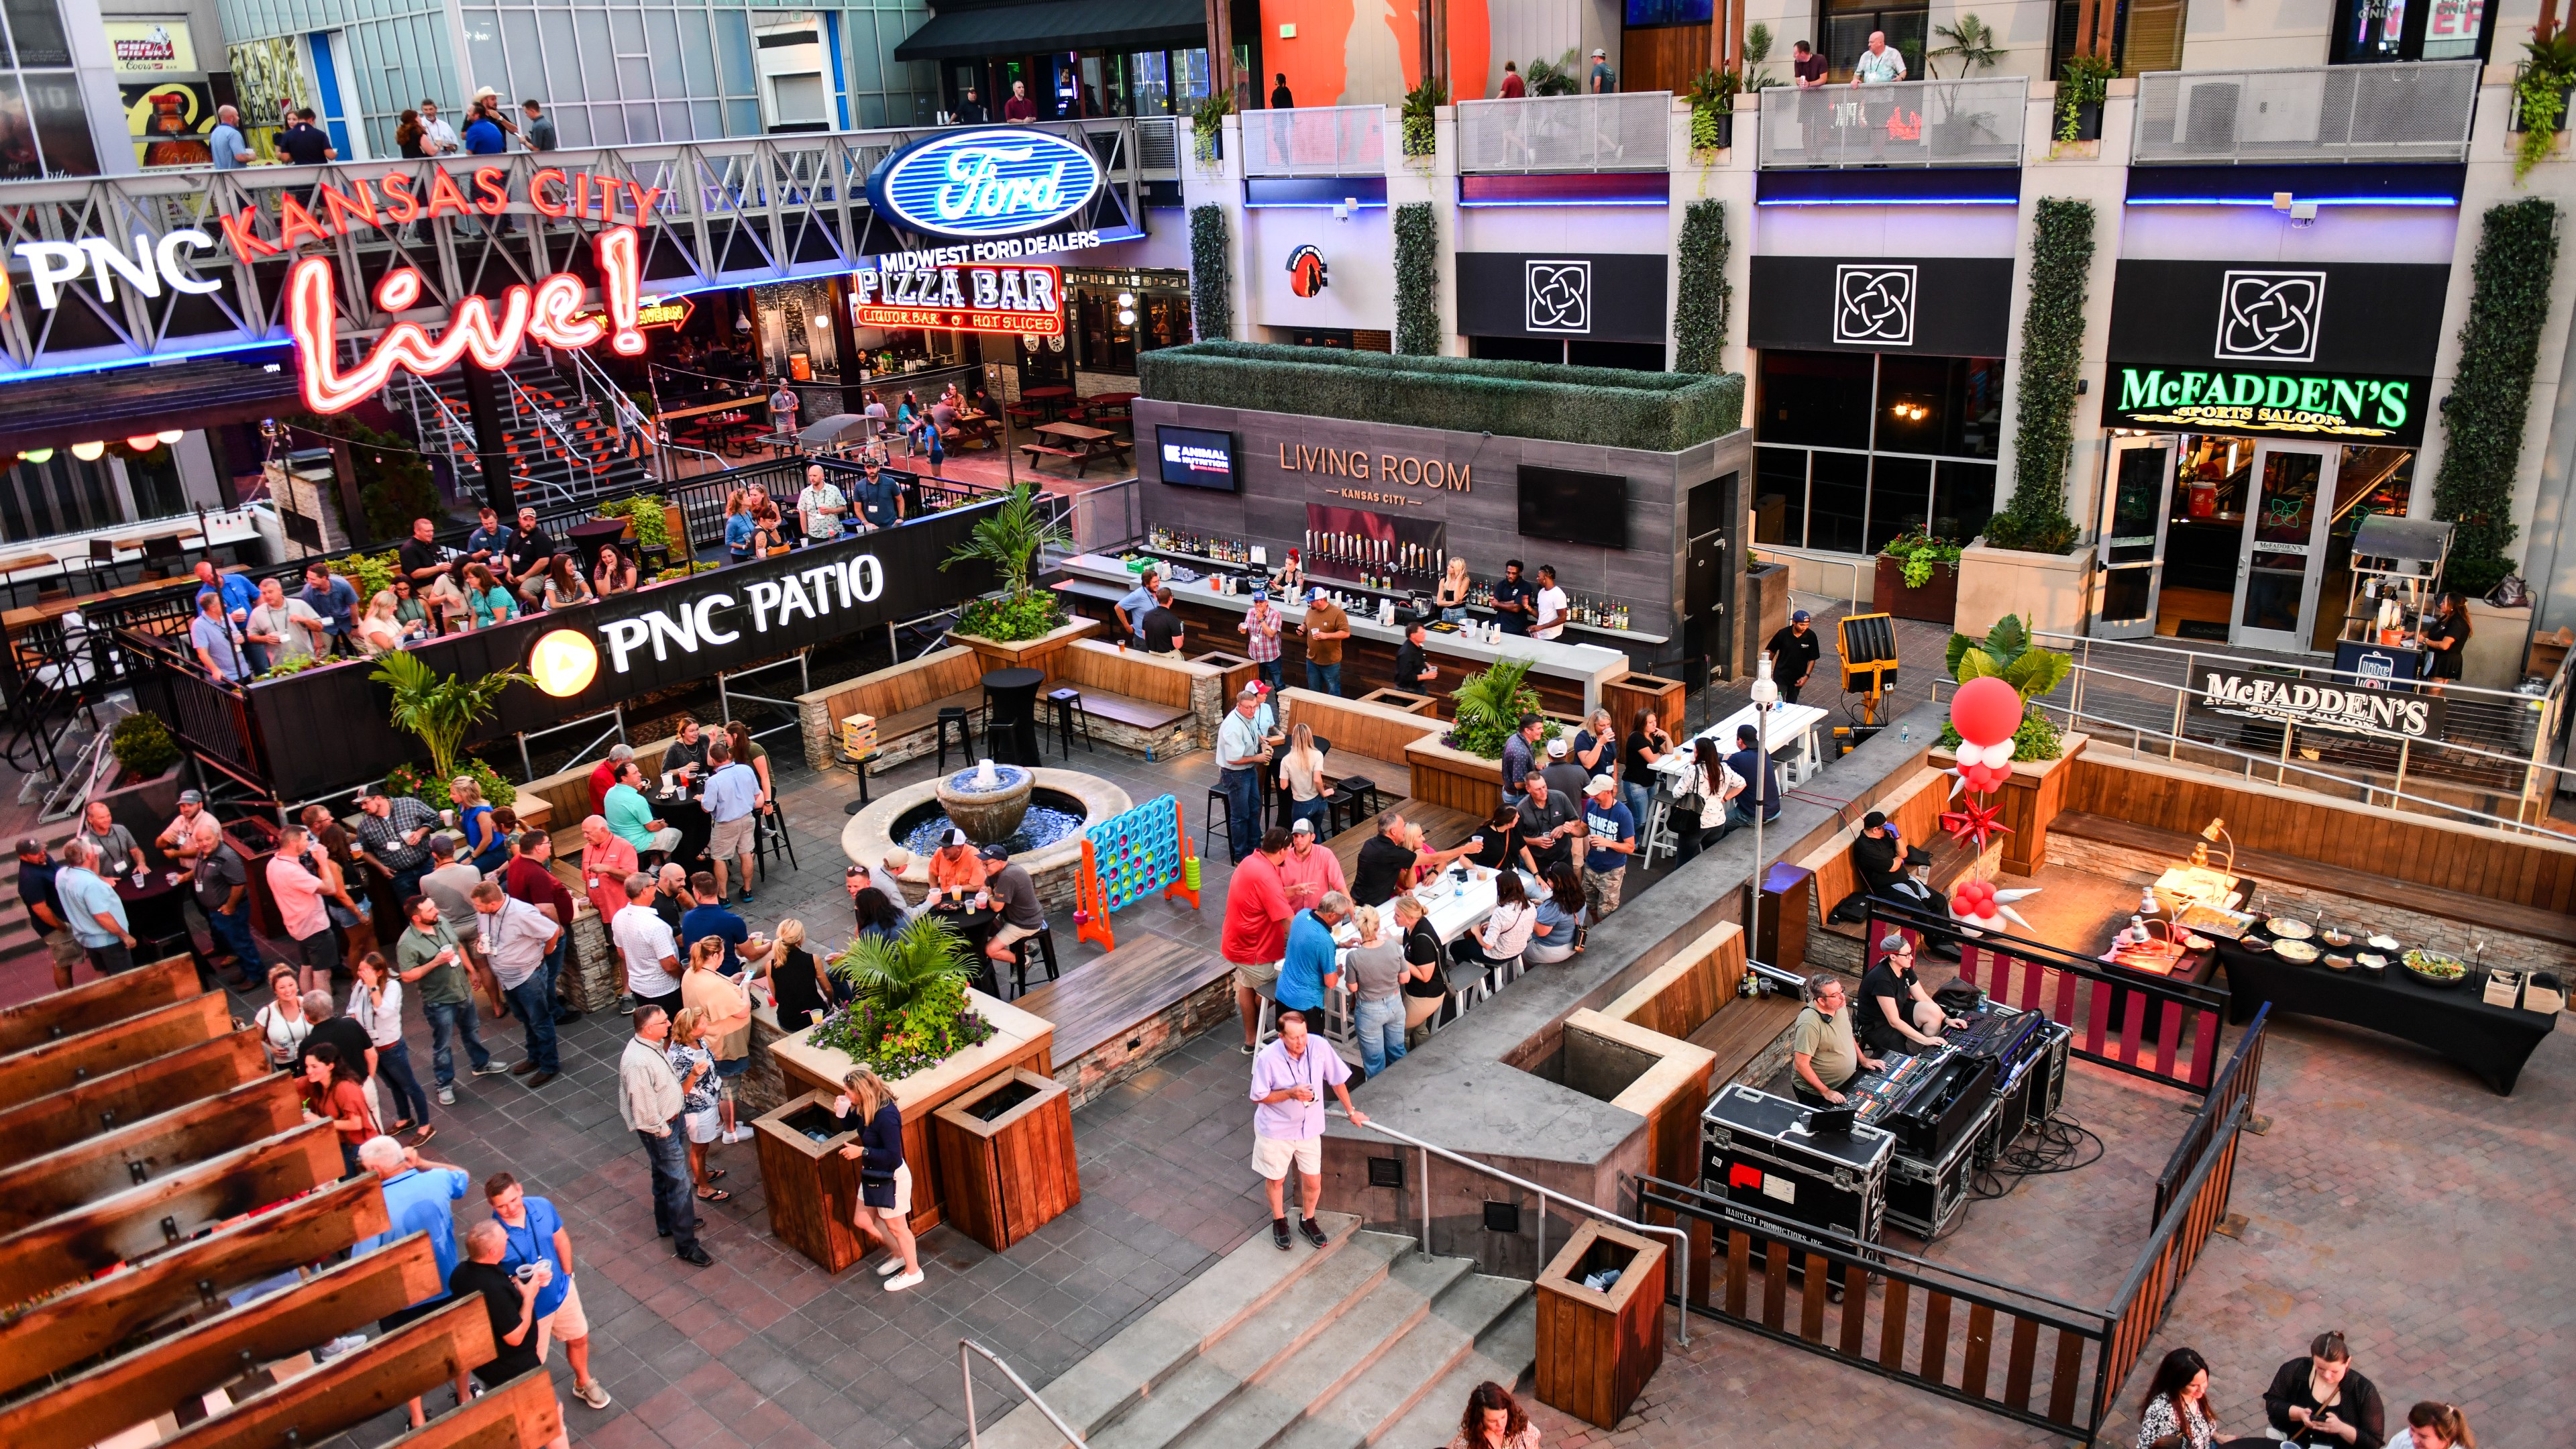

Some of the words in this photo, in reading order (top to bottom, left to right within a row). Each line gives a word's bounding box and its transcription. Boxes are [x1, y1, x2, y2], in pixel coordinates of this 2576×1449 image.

[2358, 8, 2395, 19] ONLY
[2436, 4, 2481, 15] ONLY
[125, 60, 152, 70] Coors
[936, 147, 1065, 220] Ford
[219, 166, 508, 265] KANSAS
[529, 168, 660, 229] CITY
[879, 245, 970, 272] MIDWEST
[973, 237, 1023, 262] FORD
[1025, 230, 1100, 256] DEALERS
[14, 229, 222, 310] PNC
[857, 267, 966, 308] PIZZA
[973, 268, 1057, 312] BAR
[288, 225, 647, 414] Live!
[638, 305, 684, 325] AVERN
[863, 309, 909, 323] LIQUOR
[912, 312, 941, 326] BAR
[973, 315, 1001, 328] HOT
[1002, 315, 1055, 331] SLICES
[2118, 370, 2409, 427] McFADDEN'S
[2178, 407, 2253, 421] SPORTS
[2257, 408, 2341, 426] SALOON
[1181, 446, 1228, 461] ANIMAL
[1182, 456, 1229, 468] NUTRITION
[1279, 442, 1370, 480] LIVING
[1381, 453, 1470, 492] ROOM
[1342, 488, 1380, 502] KANSAS
[1383, 494, 1406, 506] CITY
[2259, 542, 2303, 553] McFADDEN'S
[598, 593, 739, 674] PNC
[744, 554, 884, 634] PATIO
[2202, 673, 2429, 737] McFADDEN'S
[1587, 812, 1619, 835] FARMERS
[1725, 1207, 1757, 1225] HARVEST
[1759, 1218, 1807, 1242] PRODUCTIONS
